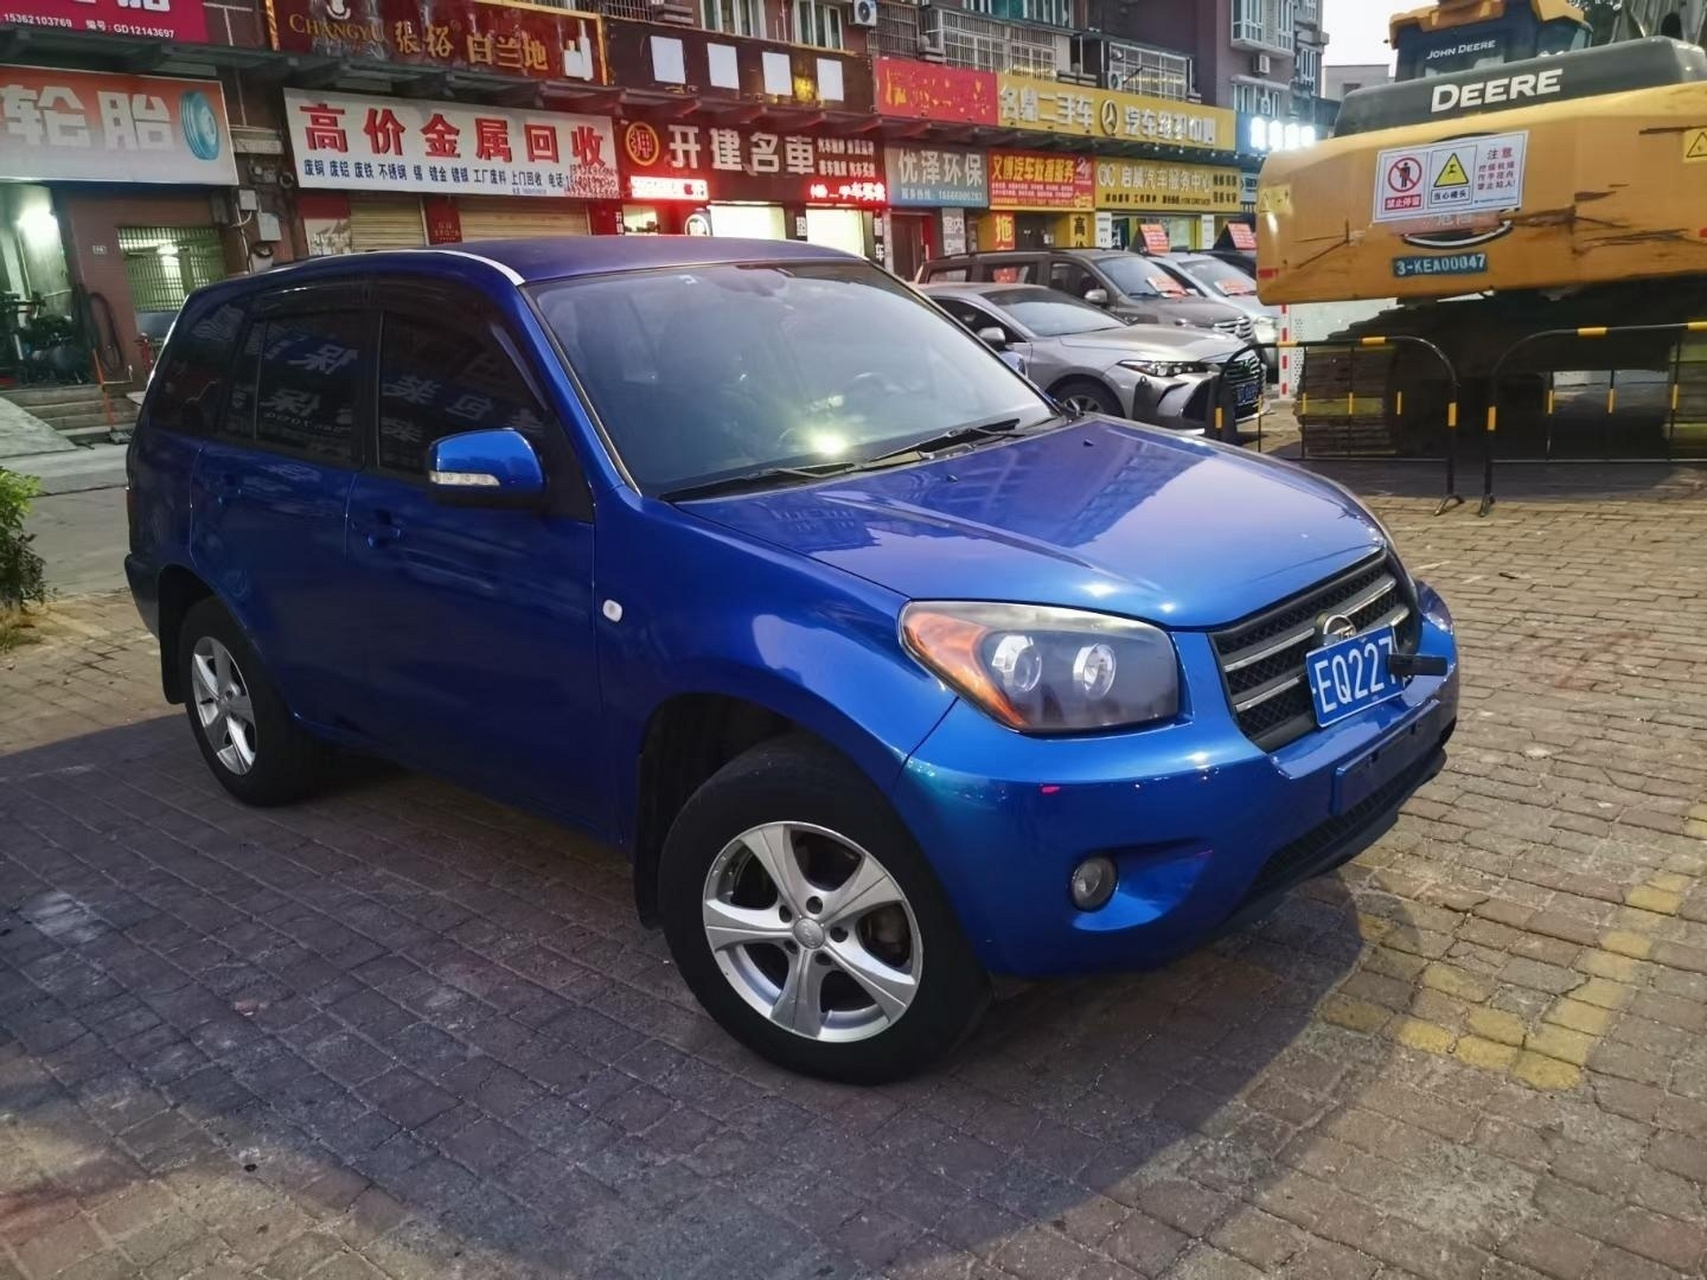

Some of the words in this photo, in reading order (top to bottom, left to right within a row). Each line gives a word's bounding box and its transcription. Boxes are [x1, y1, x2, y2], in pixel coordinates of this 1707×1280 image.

[4, 14, 72, 28] 15362103769
[288, 14, 386, 42] CHANGYU
[1426, 48, 1456, 60] JOHN
[1457, 40, 1496, 54] DEERE
[1430, 68, 1564, 113] DEERE
[0, 84, 174, 152] 轮胎
[299, 103, 607, 168] 高价金属回收
[1487, 147, 1513, 161] 注意
[354, 161, 374, 180] 废铁
[378, 163, 407, 181] 不锈钢
[473, 168, 507, 185] 工厂废料
[511, 170, 542, 187] 上门回收
[898, 148, 983, 188] 优泽环保
[1396, 253, 1486, 276] 3-KEA00047
